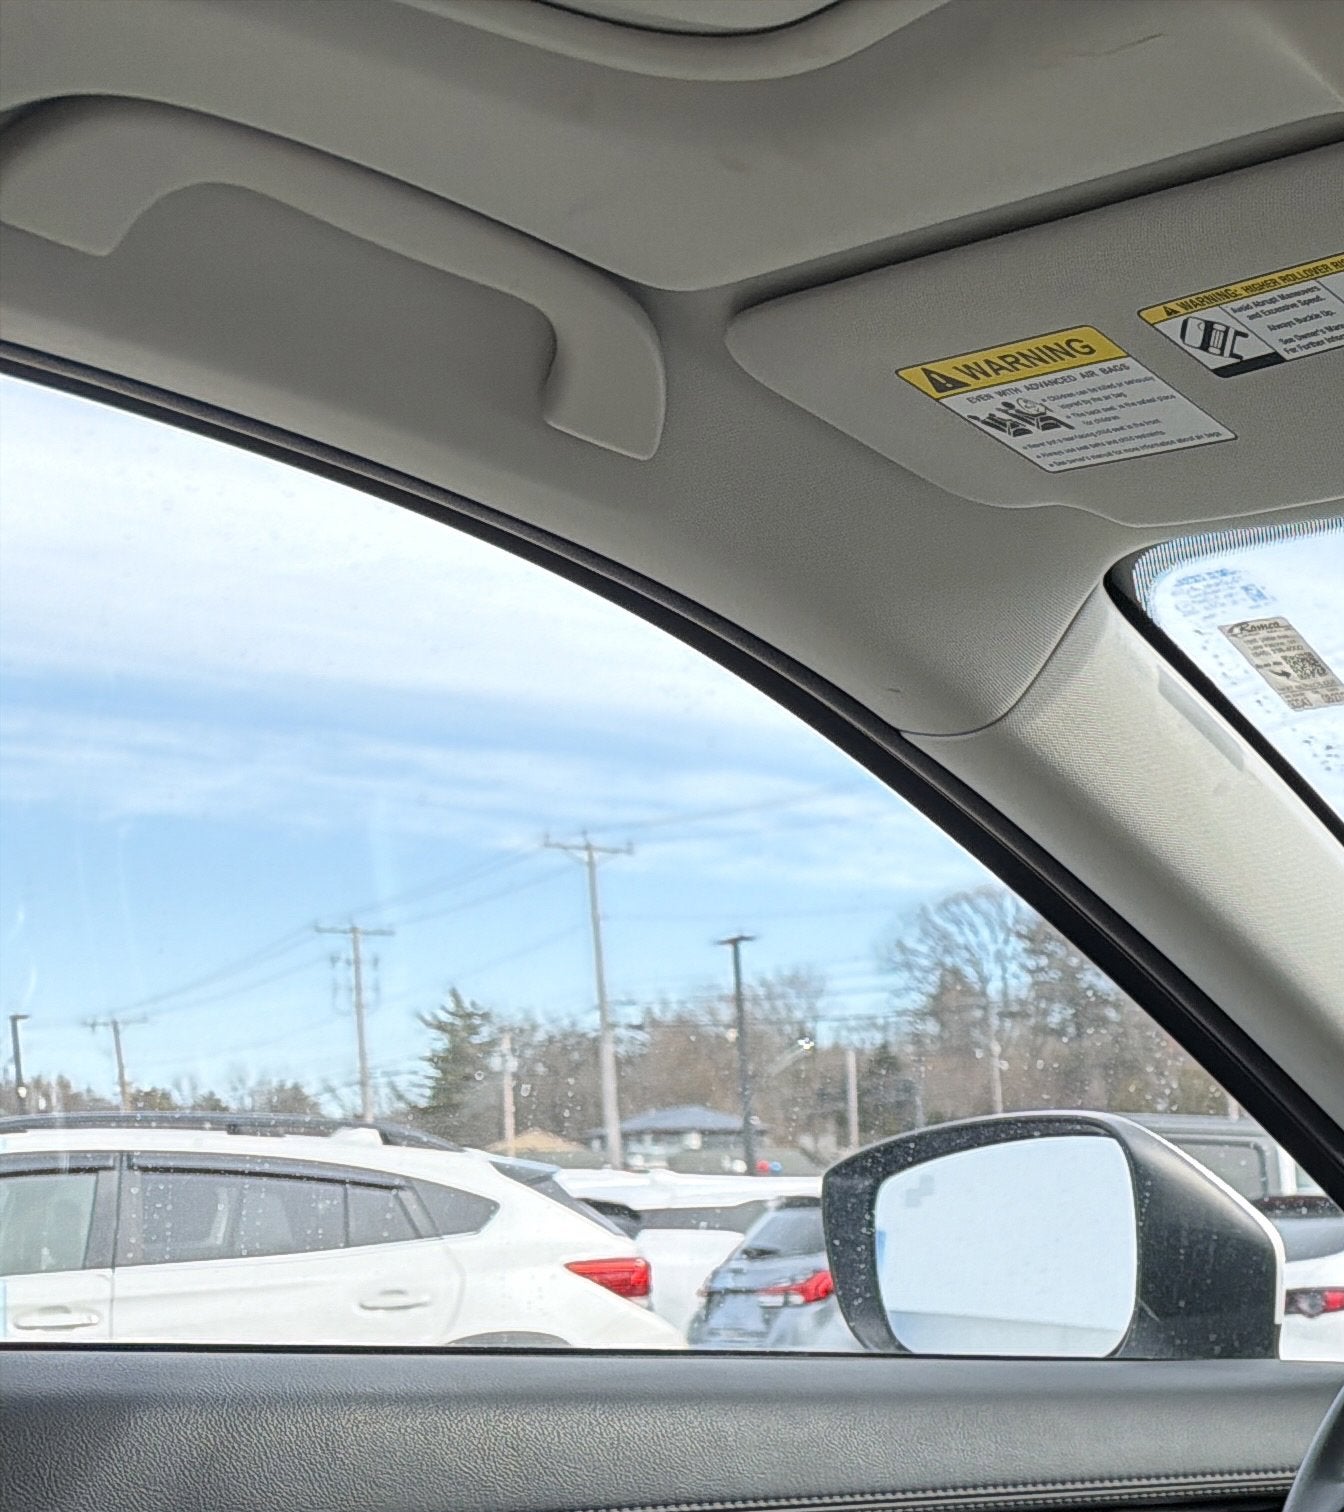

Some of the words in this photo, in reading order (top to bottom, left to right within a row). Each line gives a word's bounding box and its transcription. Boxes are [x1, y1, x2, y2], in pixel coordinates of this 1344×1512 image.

[1277, 264, 1332, 283] ROLLOVER
[951, 337, 1099, 381] WARNING
[964, 394, 995, 403] EVEN
[994, 387, 1023, 397] WITH
[1021, 375, 1078, 391] ADVANCED
[1077, 370, 1098, 379] AIR
[1098, 363, 1131, 374] BAGS
